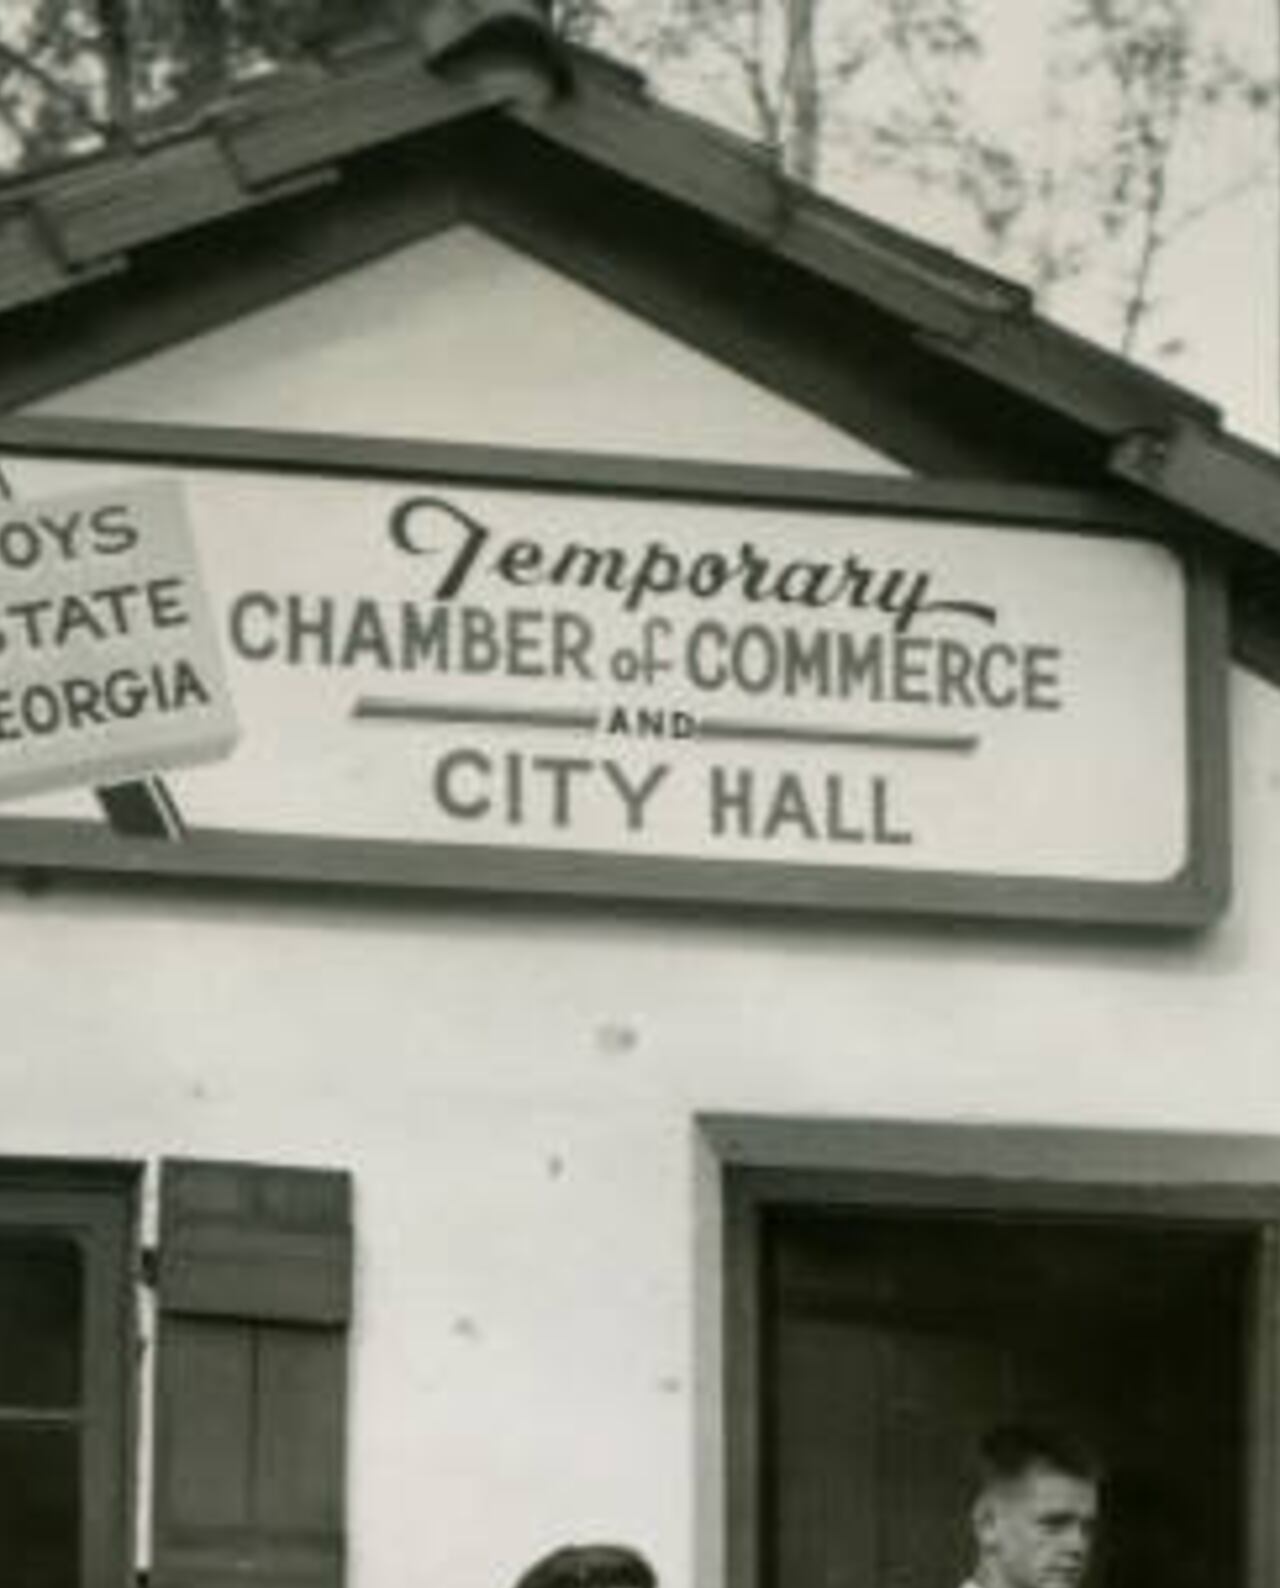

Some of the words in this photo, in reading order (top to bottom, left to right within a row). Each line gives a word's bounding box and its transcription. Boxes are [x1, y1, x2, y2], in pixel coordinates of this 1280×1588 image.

[387, 494, 997, 635] Temporary
[228, 592, 594, 680] CHAMBER
[611, 615, 674, 686] of
[684, 622, 1062, 712] COMMERCE
[605, 706, 696, 742] AND
[432, 750, 668, 828] CITY
[710, 769, 914, 846] HALL
